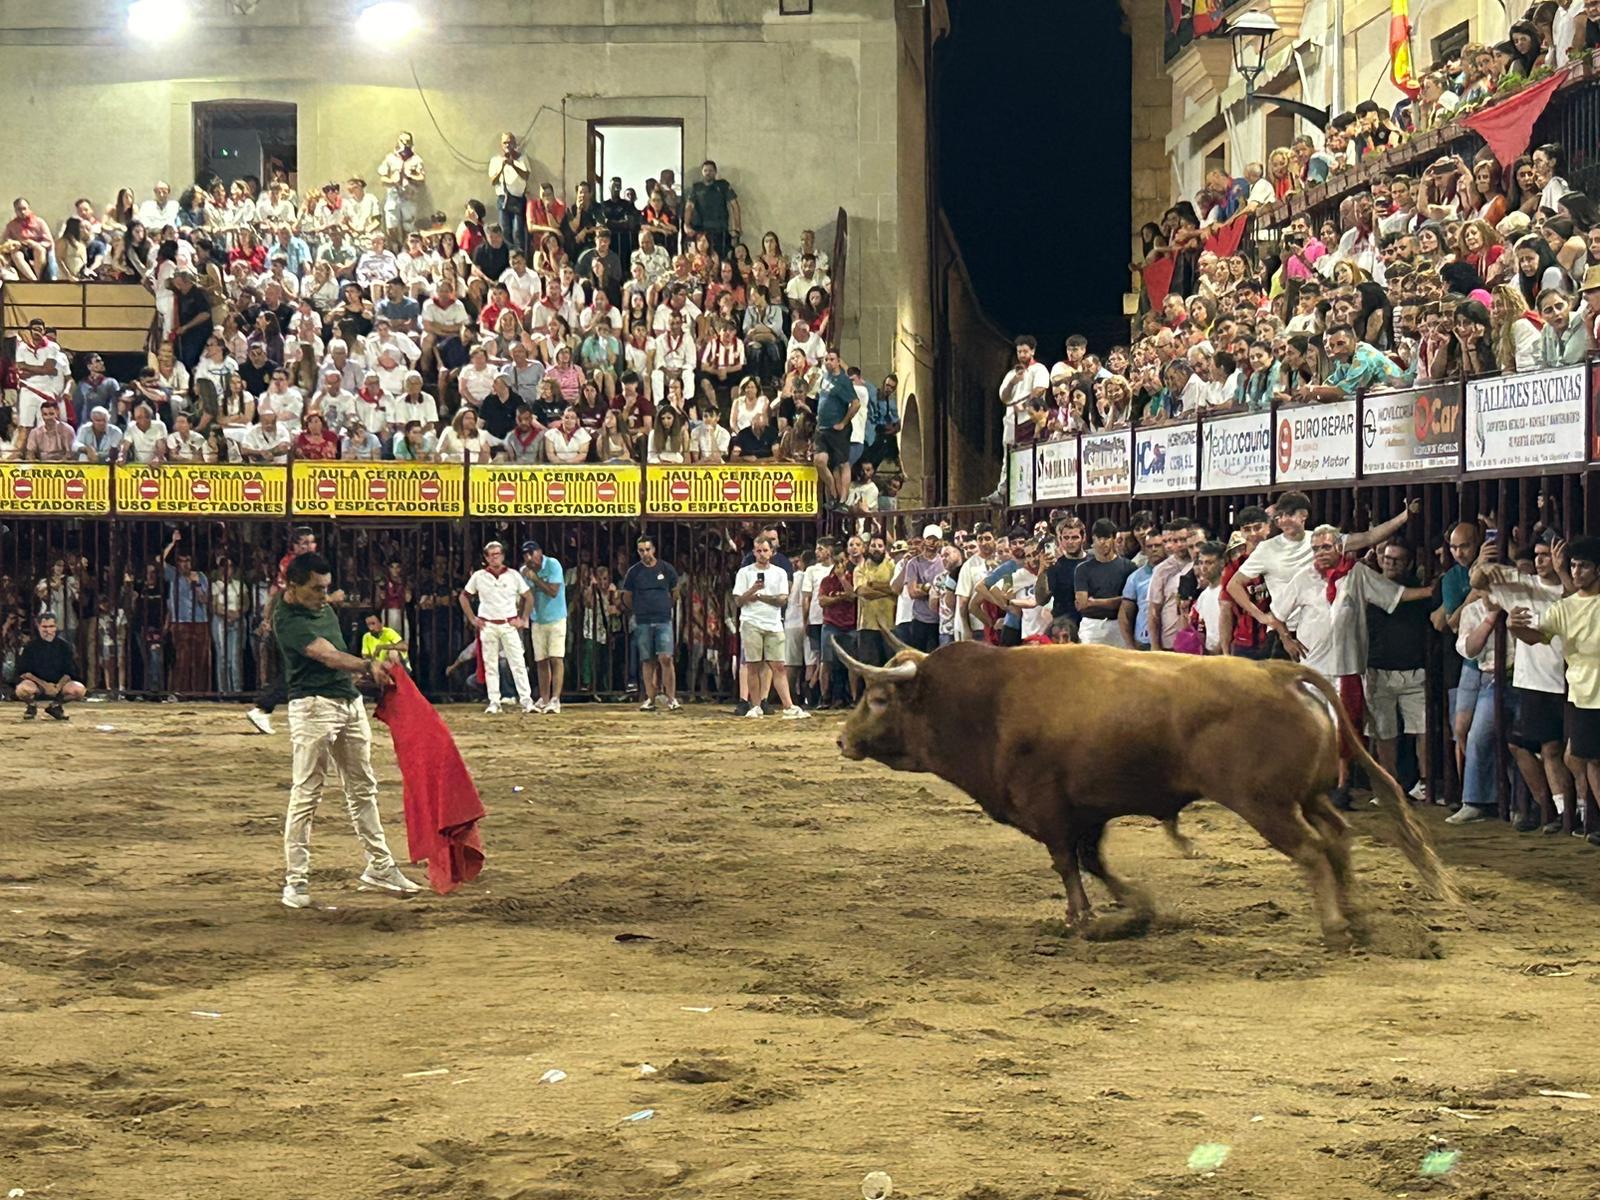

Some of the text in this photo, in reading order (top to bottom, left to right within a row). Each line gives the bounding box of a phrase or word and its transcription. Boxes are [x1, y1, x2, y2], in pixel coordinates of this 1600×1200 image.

[1532, 374, 1582, 406] ENCINAS
[1321, 455, 1350, 468] Motor
[10, 469, 85, 478] CERRADA
[131, 468, 263, 480] JAULA CERRADA
[308, 469, 441, 480] JAULA CERRADA
[489, 472, 617, 482] JAULA CERRADA
[662, 471, 794, 481] JAULA CERRADA
[119, 500, 284, 512] USO ESPECTADORES
[296, 500, 460, 512] USO ESPECTADORES
[477, 503, 637, 514] USO ESPECTADORES
[650, 502, 815, 512] USO ESPECTADORES
